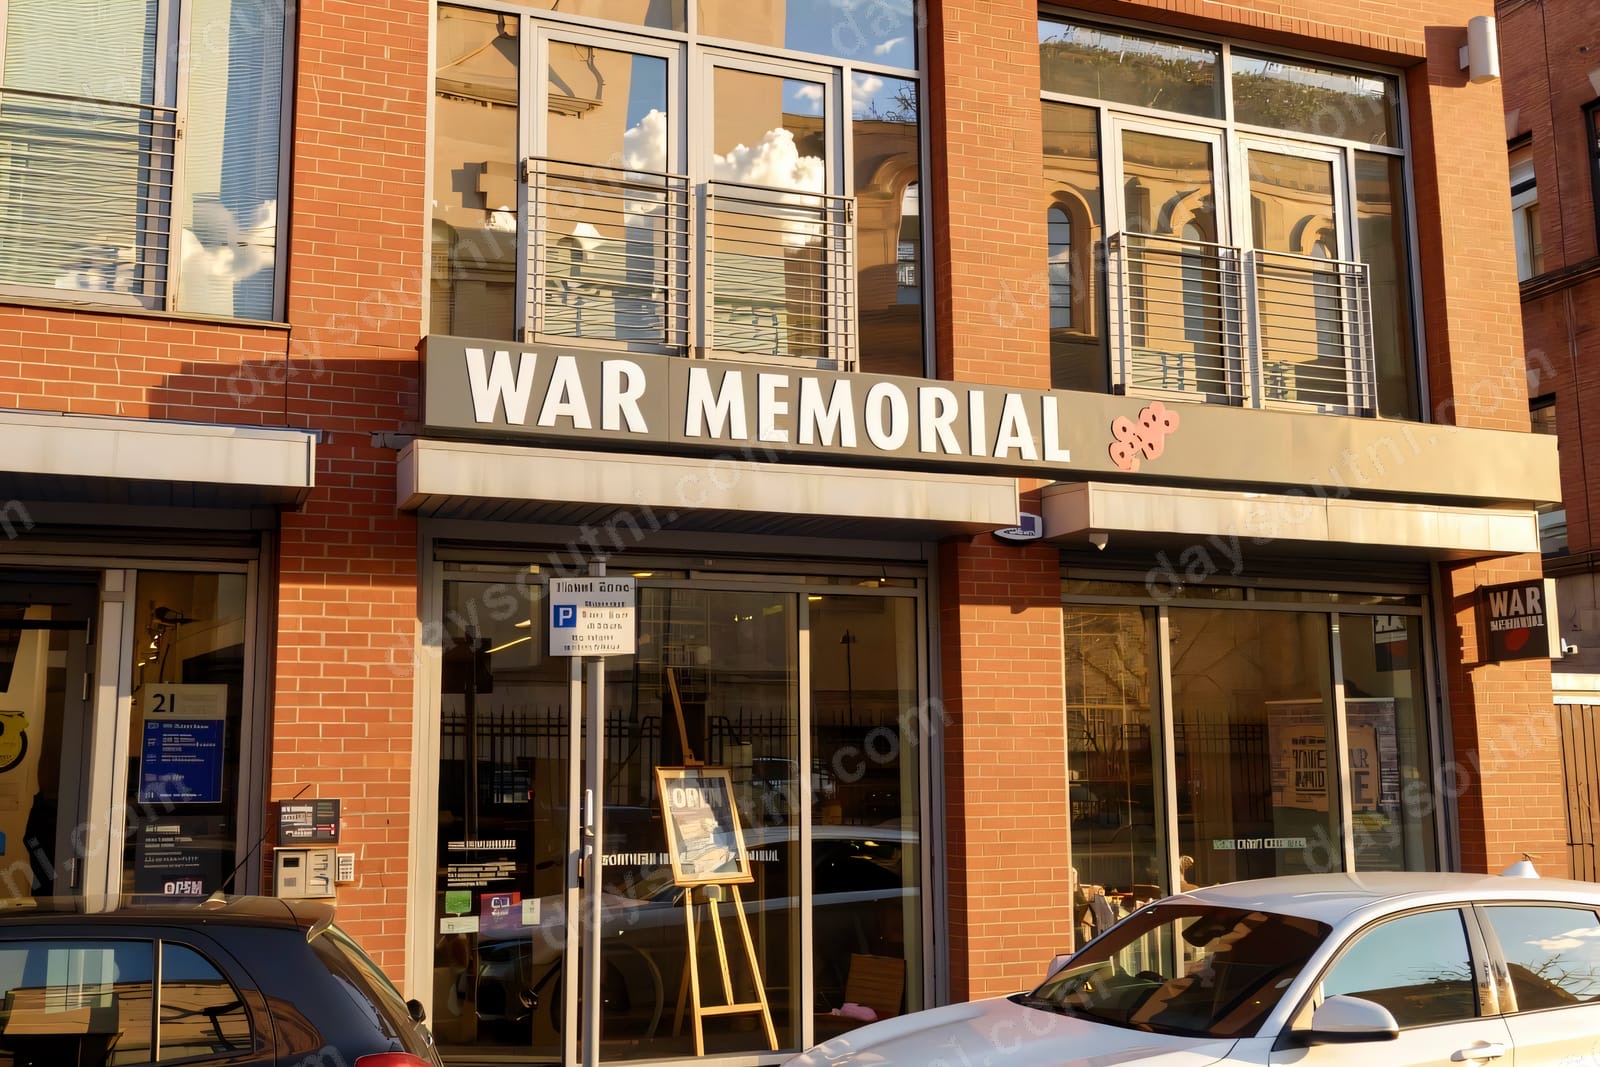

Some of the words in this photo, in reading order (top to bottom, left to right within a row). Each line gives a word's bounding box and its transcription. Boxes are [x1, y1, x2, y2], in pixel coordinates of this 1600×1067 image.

[464, 347, 650, 435] WAR
[685, 366, 1072, 463] MEMORIAL
[1489, 586, 1543, 618] WAR
[559, 607, 573, 627] P
[152, 693, 175, 713] 21
